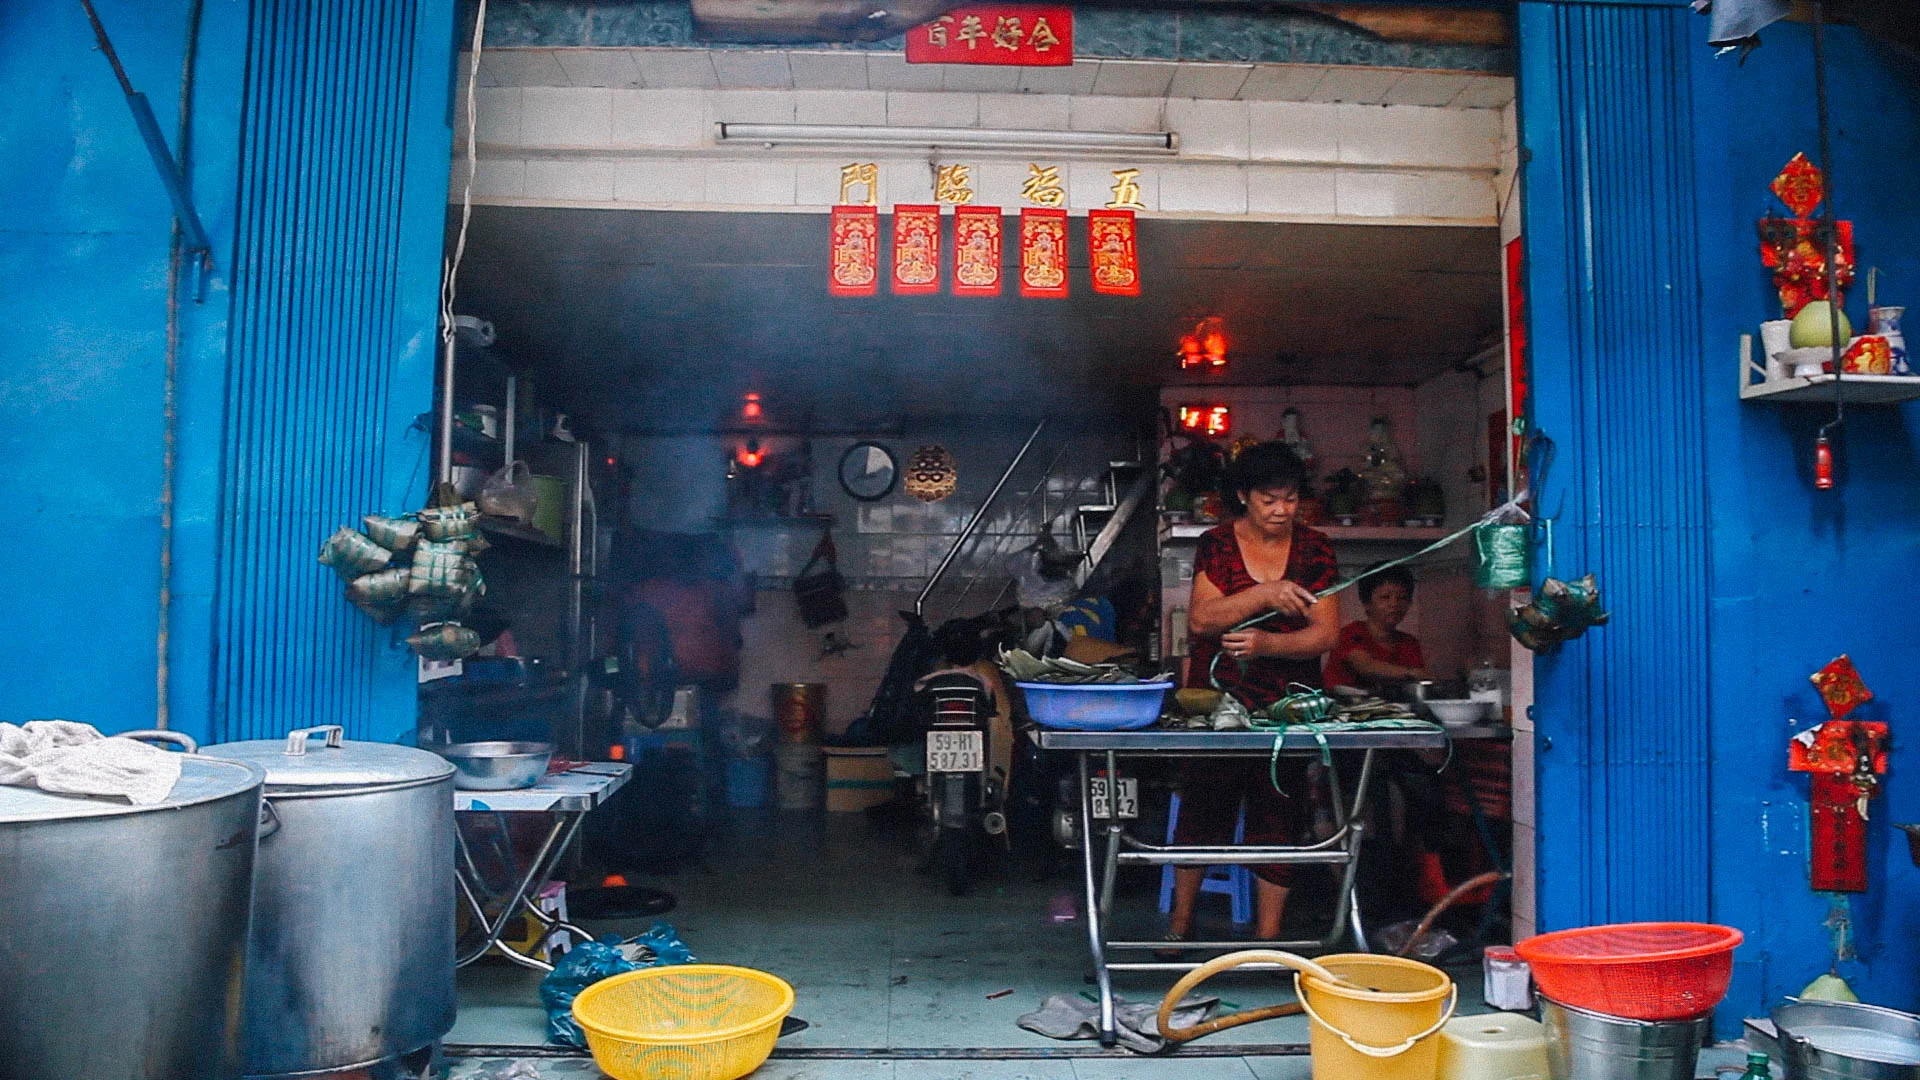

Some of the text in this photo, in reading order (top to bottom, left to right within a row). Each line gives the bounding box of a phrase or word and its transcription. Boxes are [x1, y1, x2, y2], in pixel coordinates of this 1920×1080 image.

[922, 15, 1060, 52] 百年好合
[935, 733, 973, 751] 59-H1
